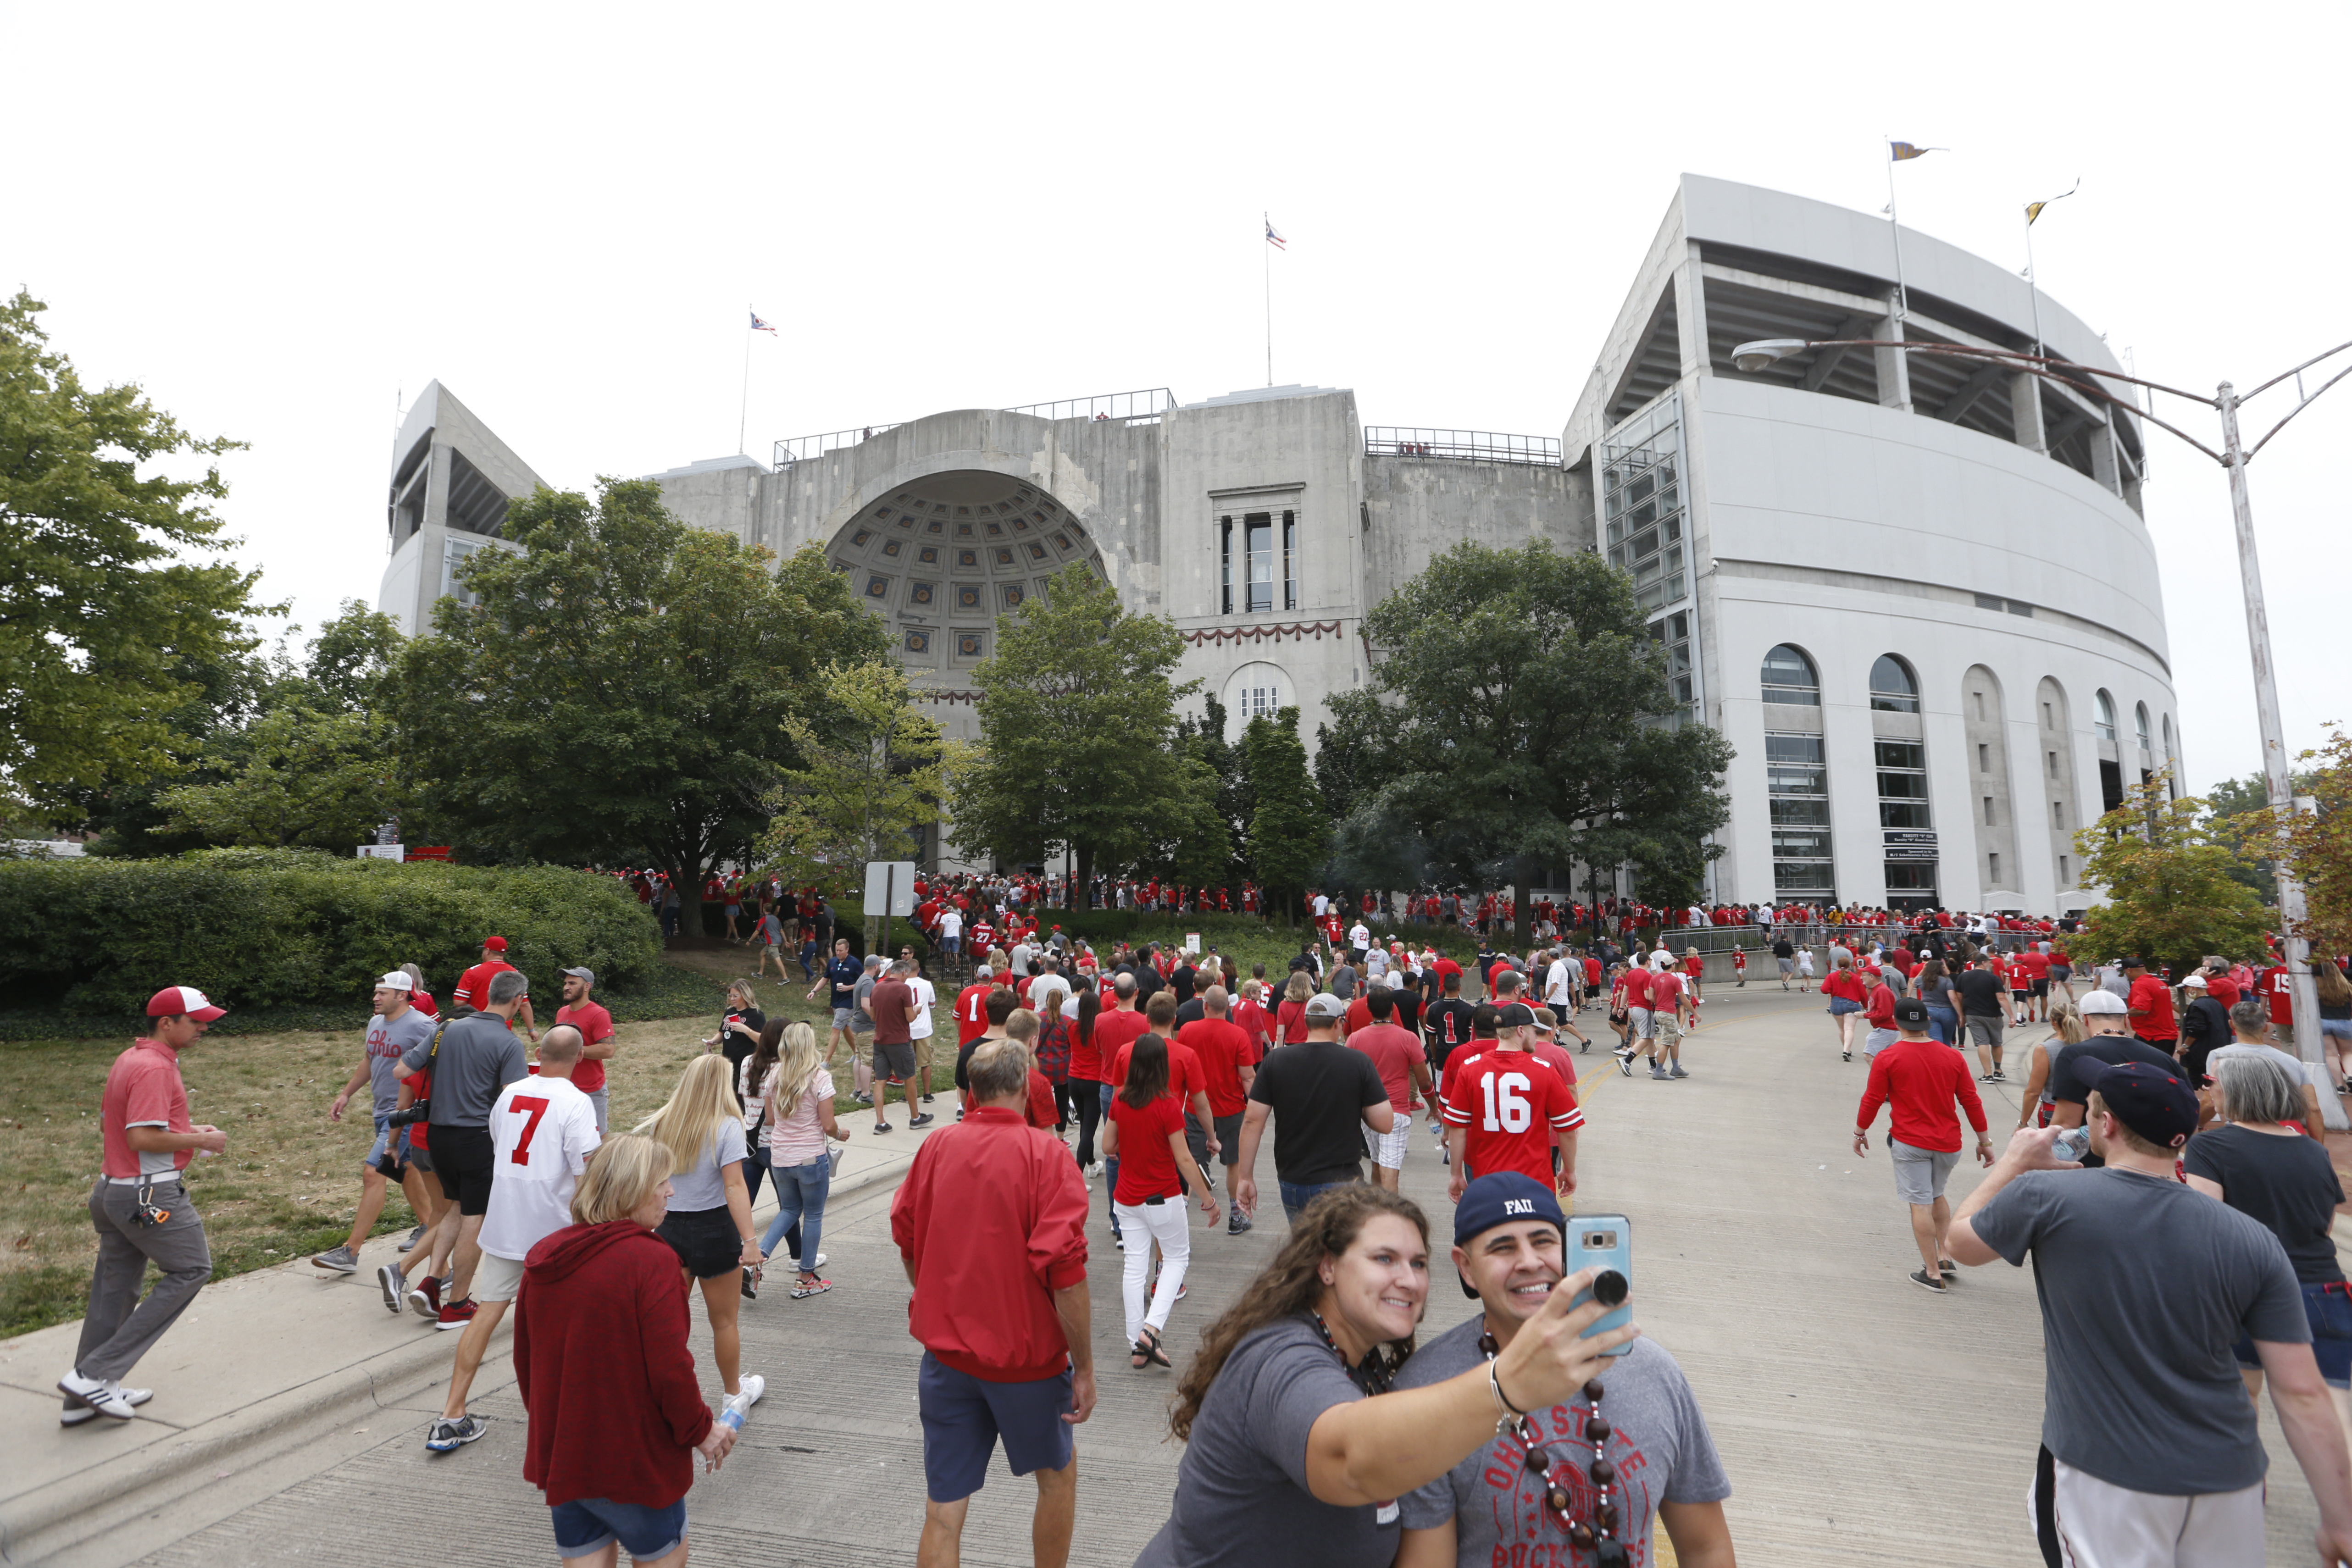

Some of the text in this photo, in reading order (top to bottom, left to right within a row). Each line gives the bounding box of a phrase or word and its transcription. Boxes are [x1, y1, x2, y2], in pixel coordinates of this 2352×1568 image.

[1636, 908, 1642, 917] 17
[976, 932, 990, 943] 27
[1359, 932, 1368, 941] 27
[2013, 967, 2019, 977] 1
[969, 993, 979, 1021] 1
[433, 1031, 444, 1043] D750
[1443, 1011, 1457, 1043] 1
[367, 1030, 402, 1058] Ohio
[1480, 1072, 1531, 1134] 16
[508, 1095, 550, 1166] 7
[1551, 1405, 1648, 1480] STTE
